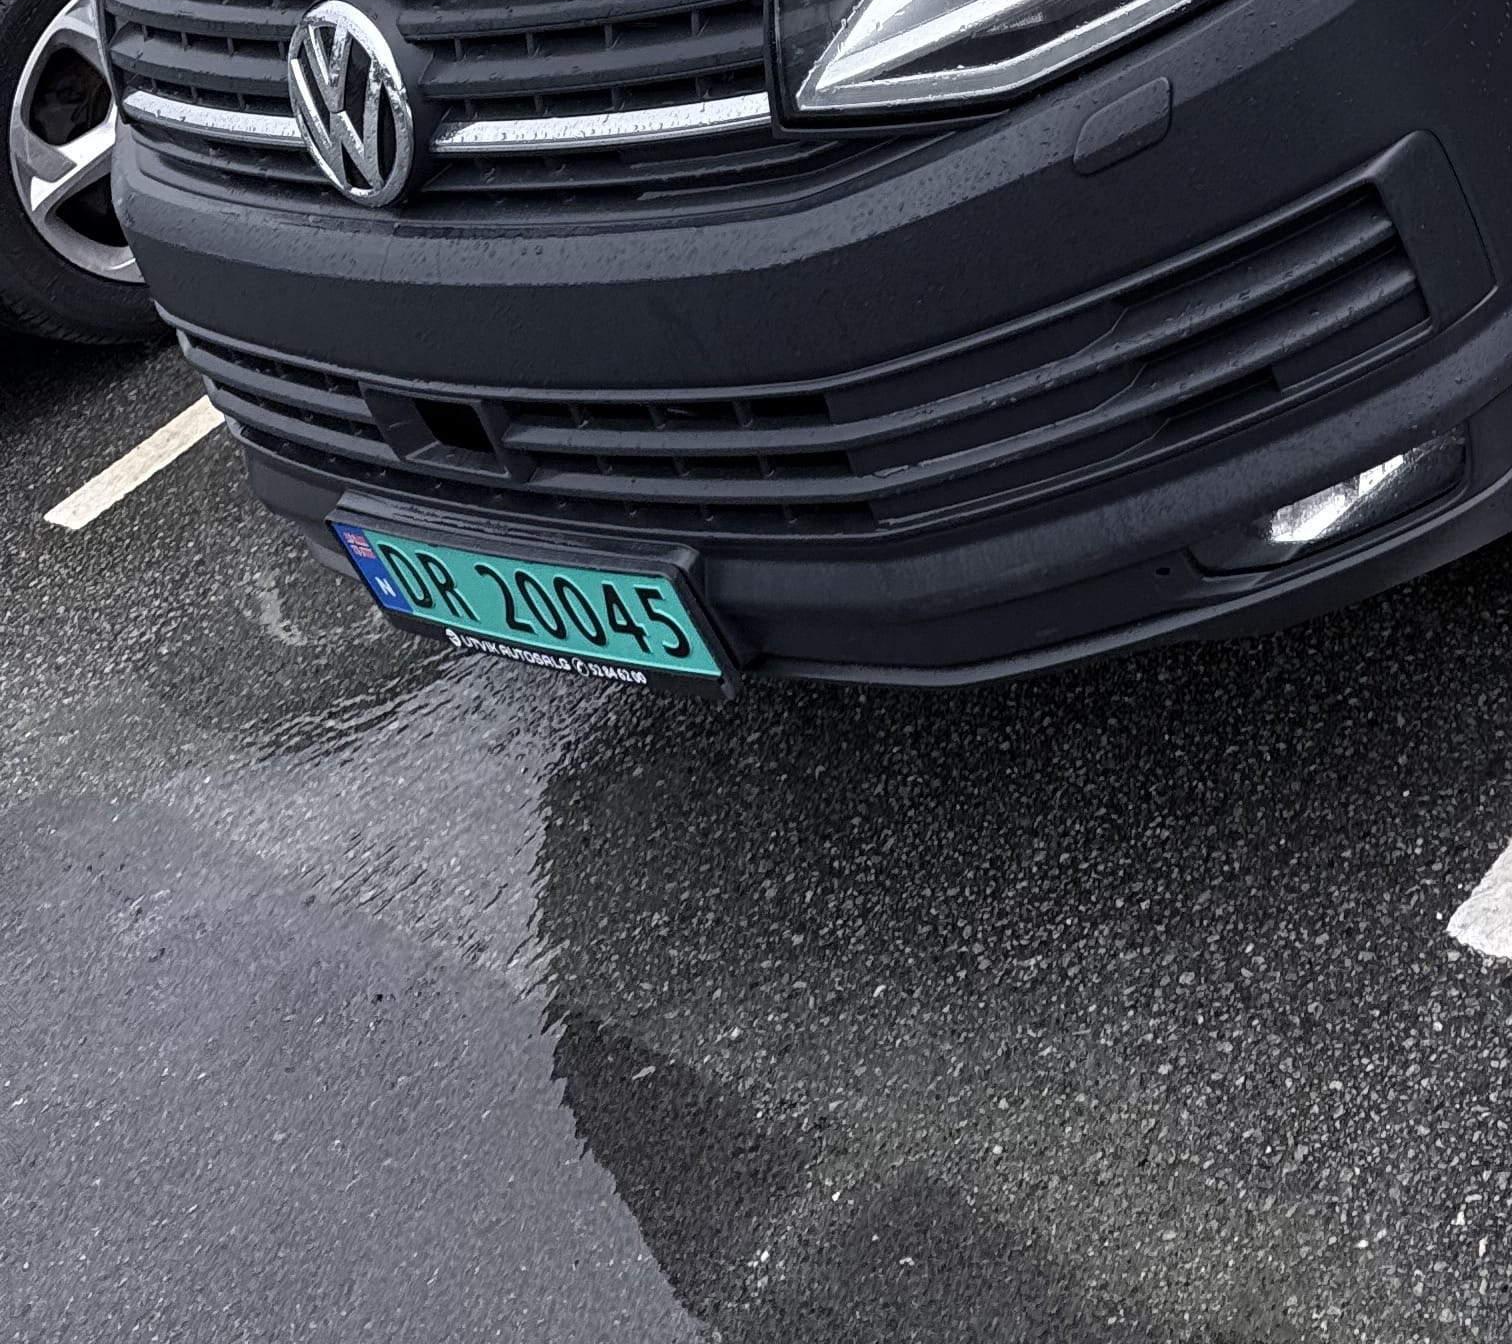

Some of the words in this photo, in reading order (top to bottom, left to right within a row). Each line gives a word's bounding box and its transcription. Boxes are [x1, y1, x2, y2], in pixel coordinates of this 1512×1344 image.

[378, 543, 481, 622] DR
[473, 563, 692, 658] 20045
[461, 635, 500, 655] UTVIK
[498, 644, 572, 671] AUTOSALG
